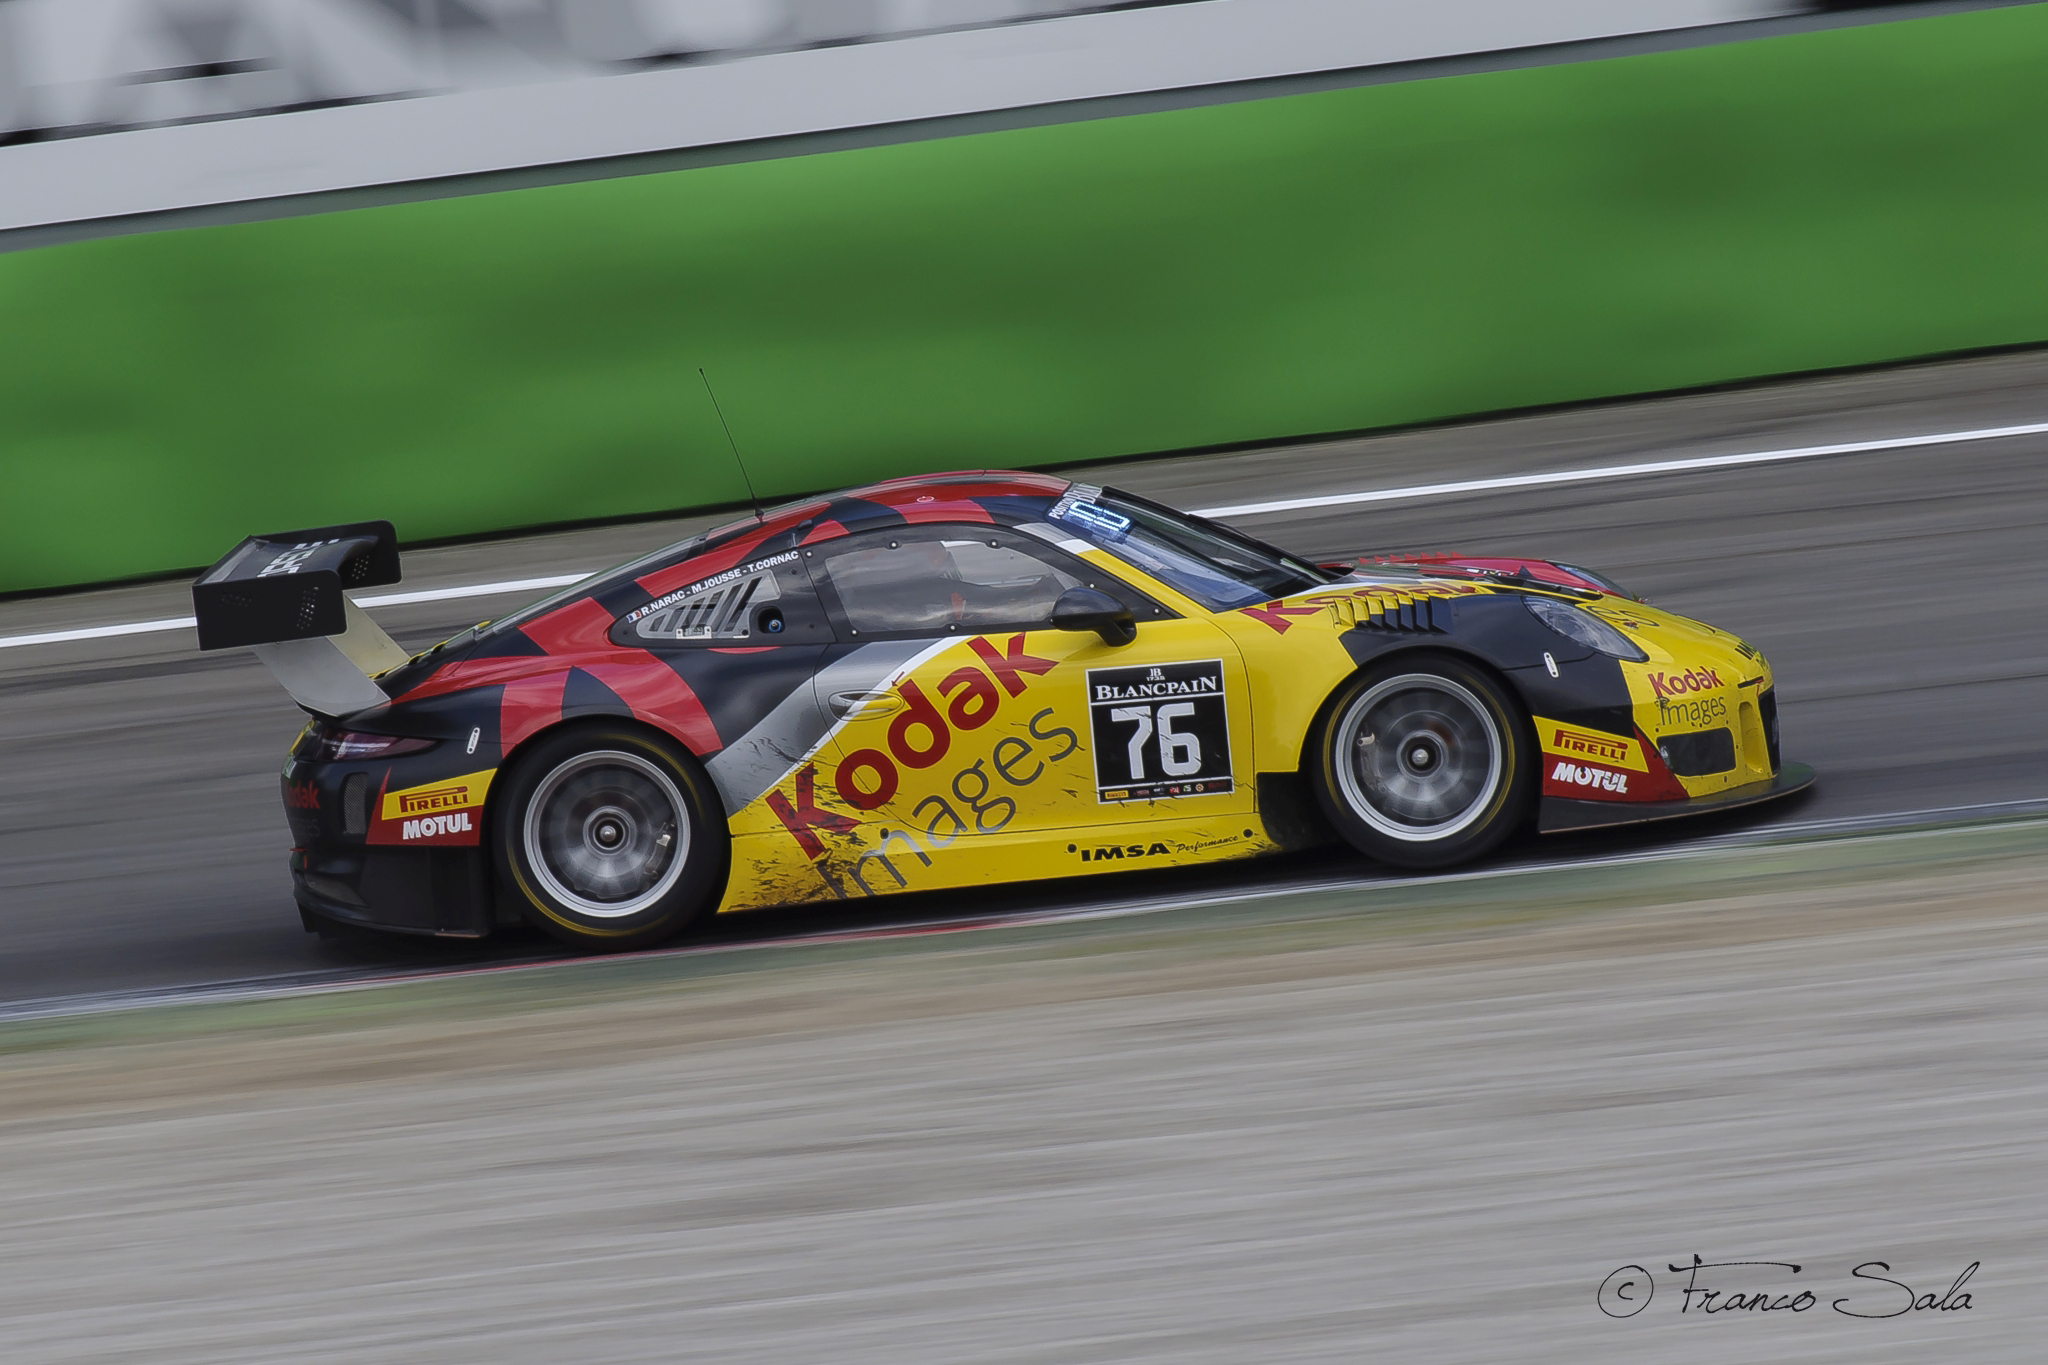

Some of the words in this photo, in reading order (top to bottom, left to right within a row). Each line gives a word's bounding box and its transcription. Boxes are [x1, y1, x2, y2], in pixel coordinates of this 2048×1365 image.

[641, 590, 686, 616] R.NARAC
[691, 568, 742, 594] M.JOUSSE
[747, 550, 799, 574] T.CORNAC
[1095, 676, 1217, 700] BLANCPAIN
[1647, 666, 1725, 699] Kodak
[764, 632, 1060, 861] Kodak
[1110, 702, 1202, 780] 76
[1553, 728, 1629, 761] PIRELLI
[1552, 761, 1628, 794] MOTUL
[398, 785, 469, 813] PIRELLI
[402, 813, 472, 840] MOTUL
[1080, 842, 1171, 862] IMSA
[1176, 835, 1239, 854] Performance
